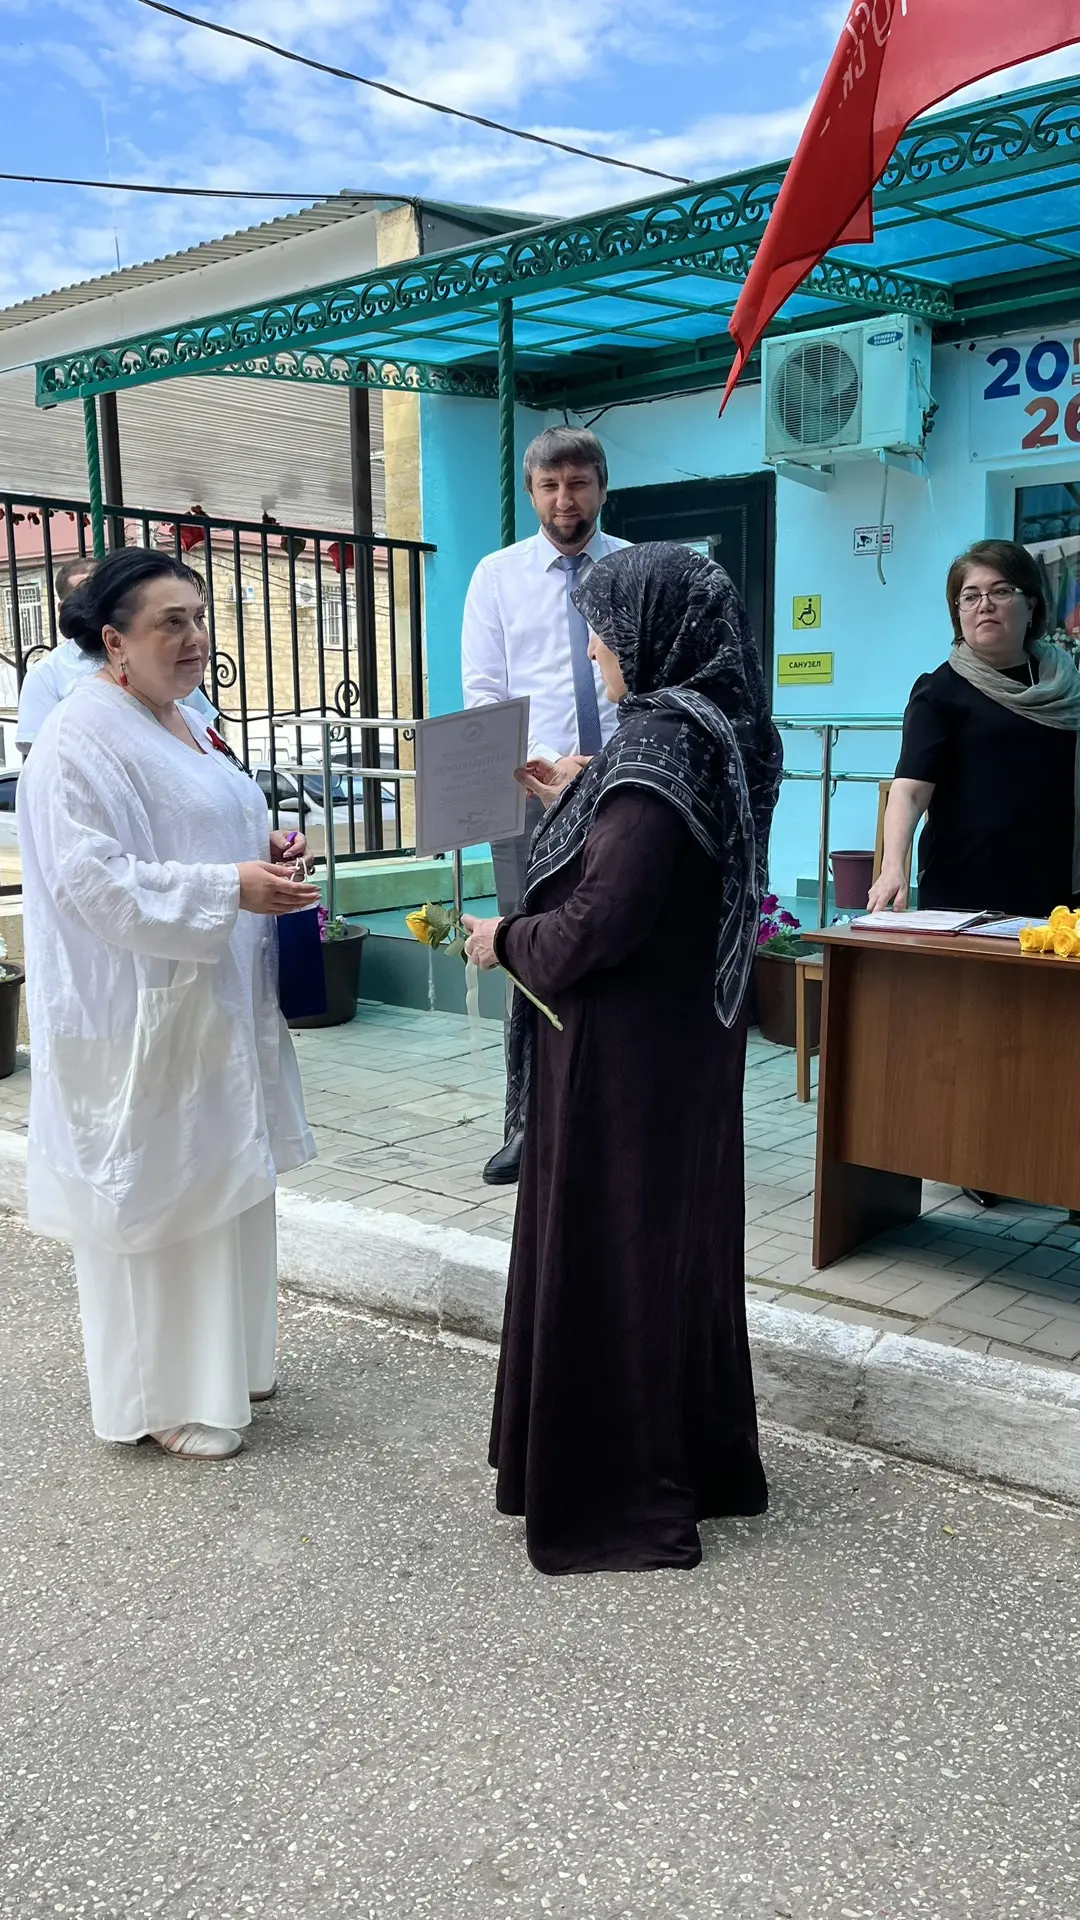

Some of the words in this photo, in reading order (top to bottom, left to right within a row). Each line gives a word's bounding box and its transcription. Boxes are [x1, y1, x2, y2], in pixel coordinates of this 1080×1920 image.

[874, 332, 896, 340] GENERAL
[874, 337, 896, 345] CLIMATE
[984, 341, 1070, 400] 20
